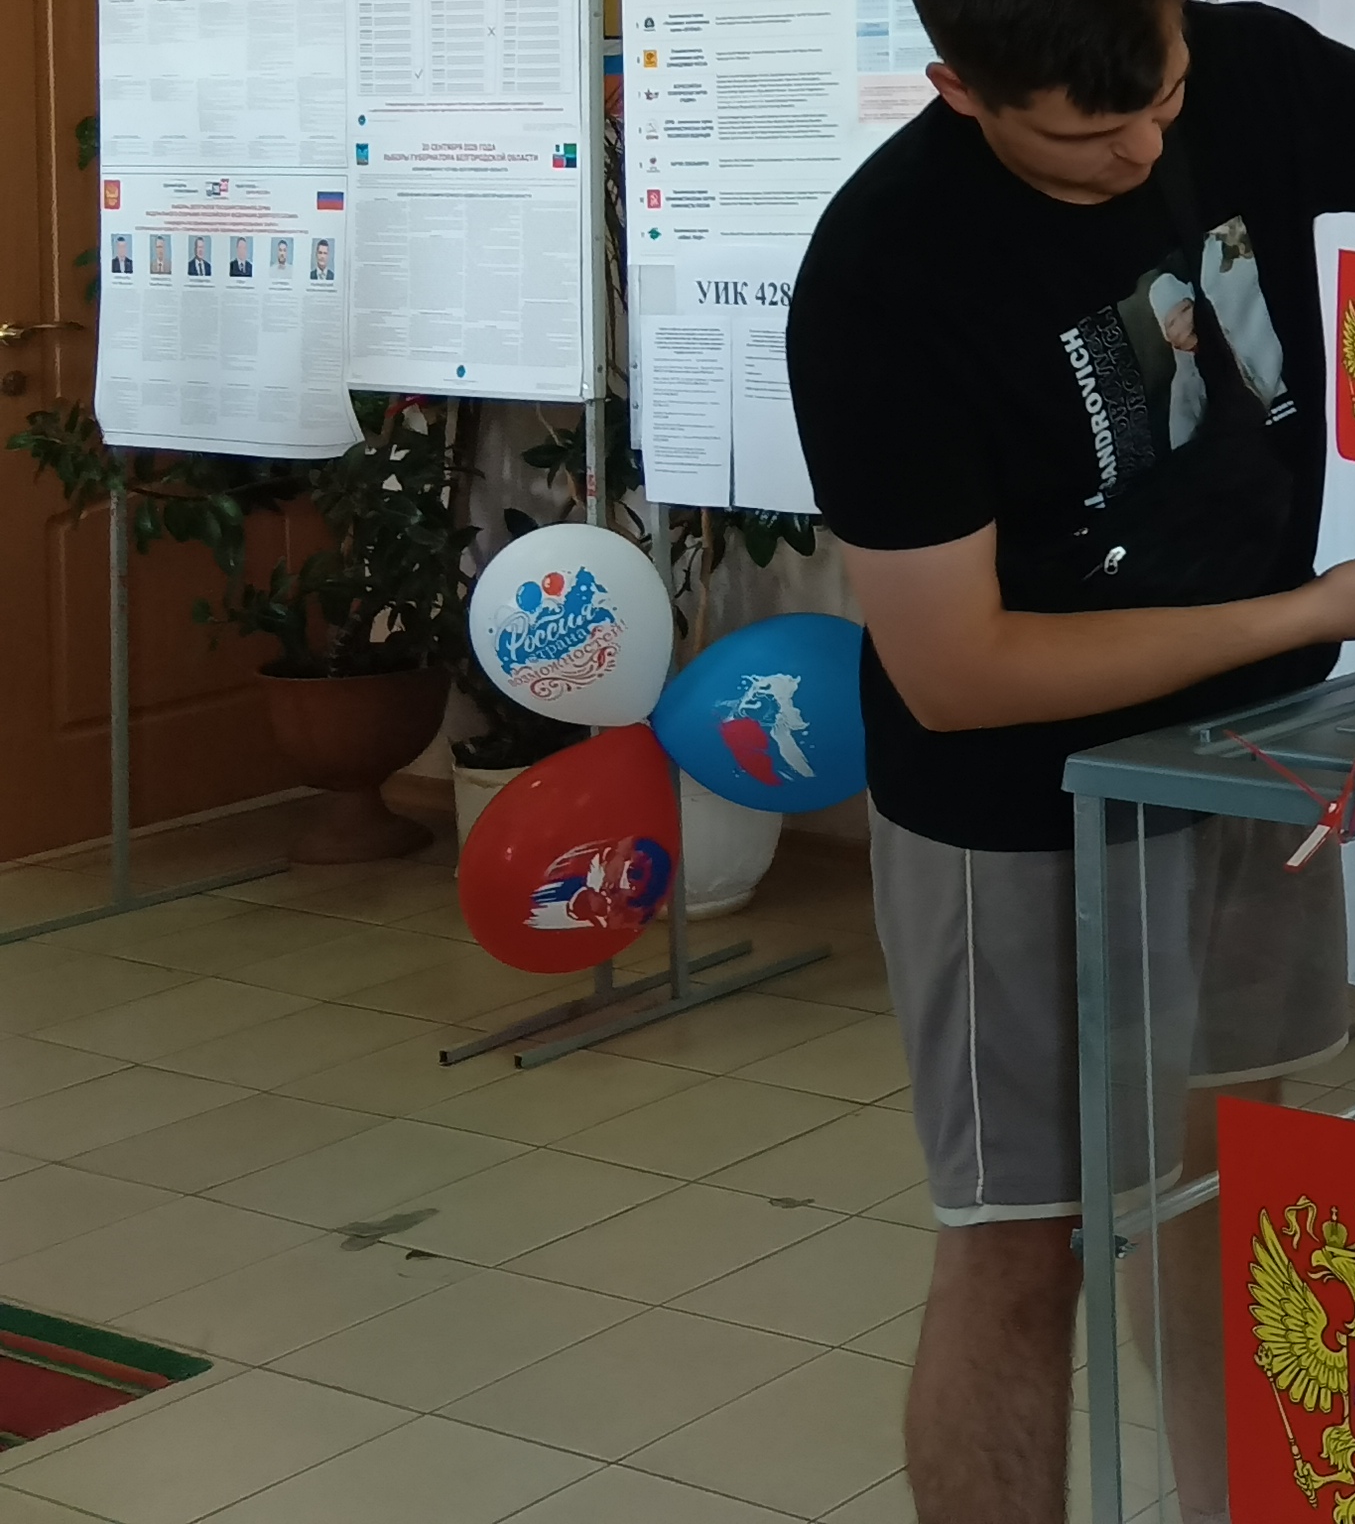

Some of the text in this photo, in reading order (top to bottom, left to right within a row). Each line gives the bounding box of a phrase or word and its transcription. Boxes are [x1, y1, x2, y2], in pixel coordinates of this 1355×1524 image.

[695, 280, 793, 307] УИК 428
[496, 603, 595, 661] Россия
